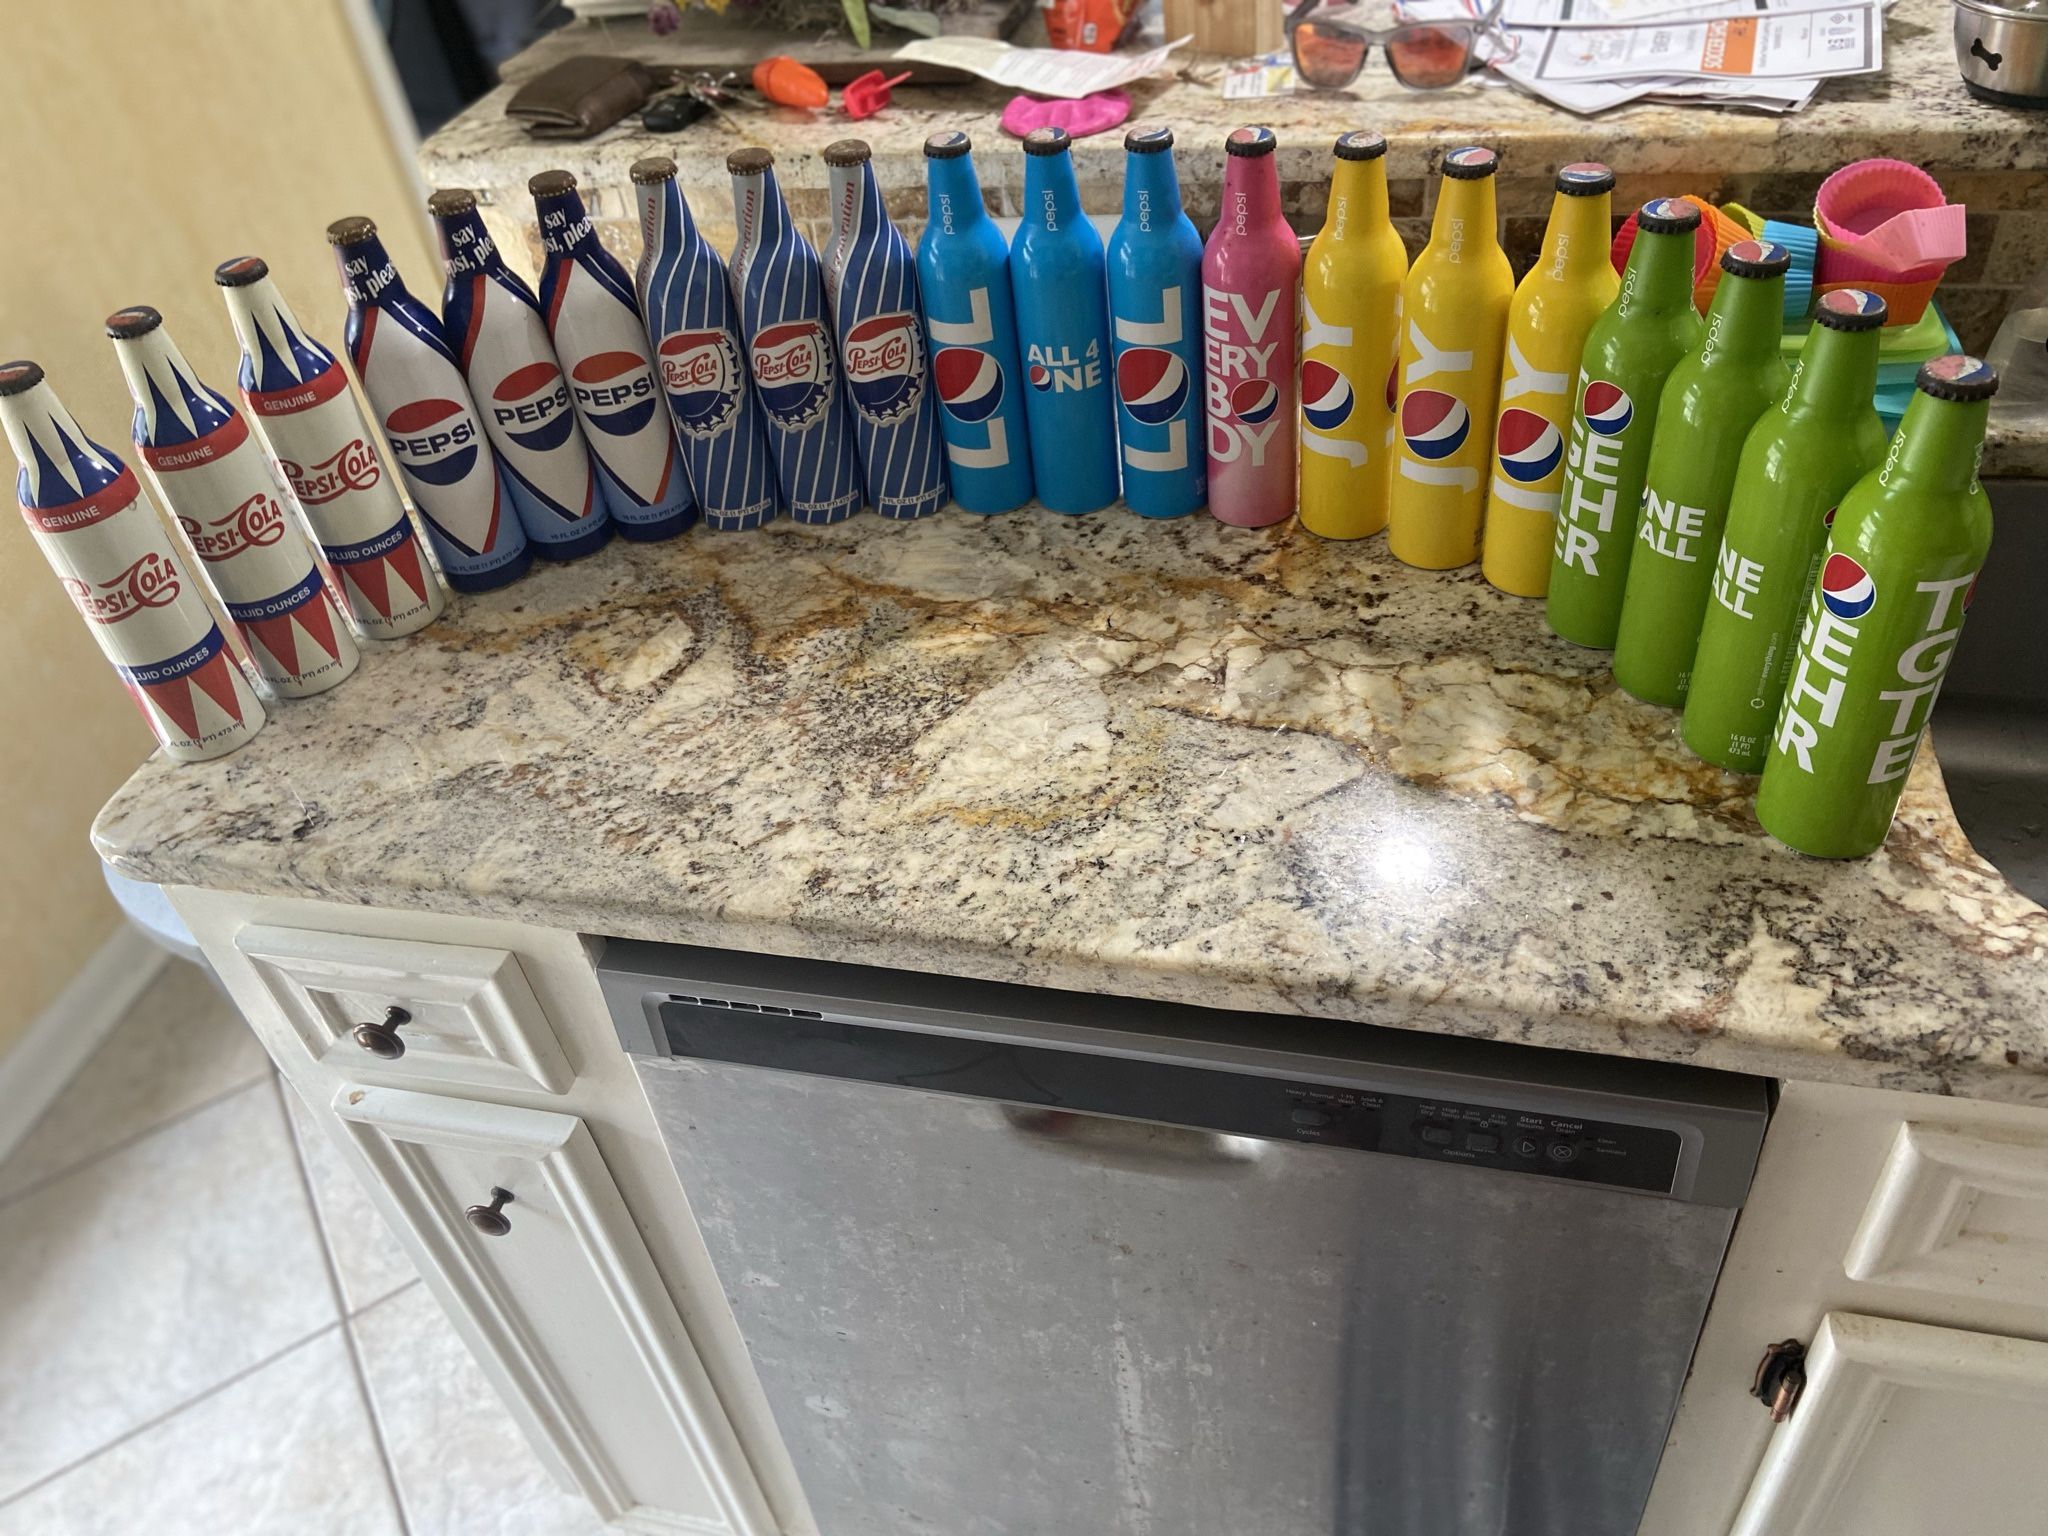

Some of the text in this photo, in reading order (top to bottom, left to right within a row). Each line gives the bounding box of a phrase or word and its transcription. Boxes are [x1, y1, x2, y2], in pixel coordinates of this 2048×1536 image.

[544, 208, 567, 229] say
[939, 194, 955, 235] pepsi
[1042, 190, 1059, 232] pepsi
[1137, 190, 1151, 233] pepsi
[1236, 192, 1248, 236] pepsi
[1335, 196, 1347, 240] pepsi
[452, 223, 476, 247] say
[562, 215, 593, 250] plea
[1449, 218, 1464, 264] pepsi
[345, 255, 368, 277] say
[1552, 233, 1570, 282] pepsi
[1618, 267, 1637, 317] pepsi
[1203, 283, 1281, 343] EV
[1027, 337, 1100, 367] ALL 4
[1700, 312, 1723, 366] pepsi
[1204, 340, 1278, 379] ERY
[264, 391, 317, 411] GENUINE
[494, 386, 568, 426] PEPS
[574, 371, 656, 407] PEPSI
[1781, 359, 1805, 414] pepsi
[157, 445, 214, 467] GENUINE
[390, 418, 476, 456] PEPSI
[1207, 419, 1281, 467] DY
[1879, 428, 1906, 487] pepsi
[41, 505, 100, 528] GENUINE
[1642, 484, 1706, 537] NE
[329, 530, 403, 561] FLUID OUNCES
[1639, 520, 1697, 563] ALL
[266, 586, 311, 614] OUNCES
[1712, 568, 1753, 620] ALL
[135, 646, 210, 681] LUID OUNCES
[1729, 747, 1740, 755] 473
[1730, 733, 1738, 741] 16
[1520, 1115, 1583, 1130] Start Cancel
